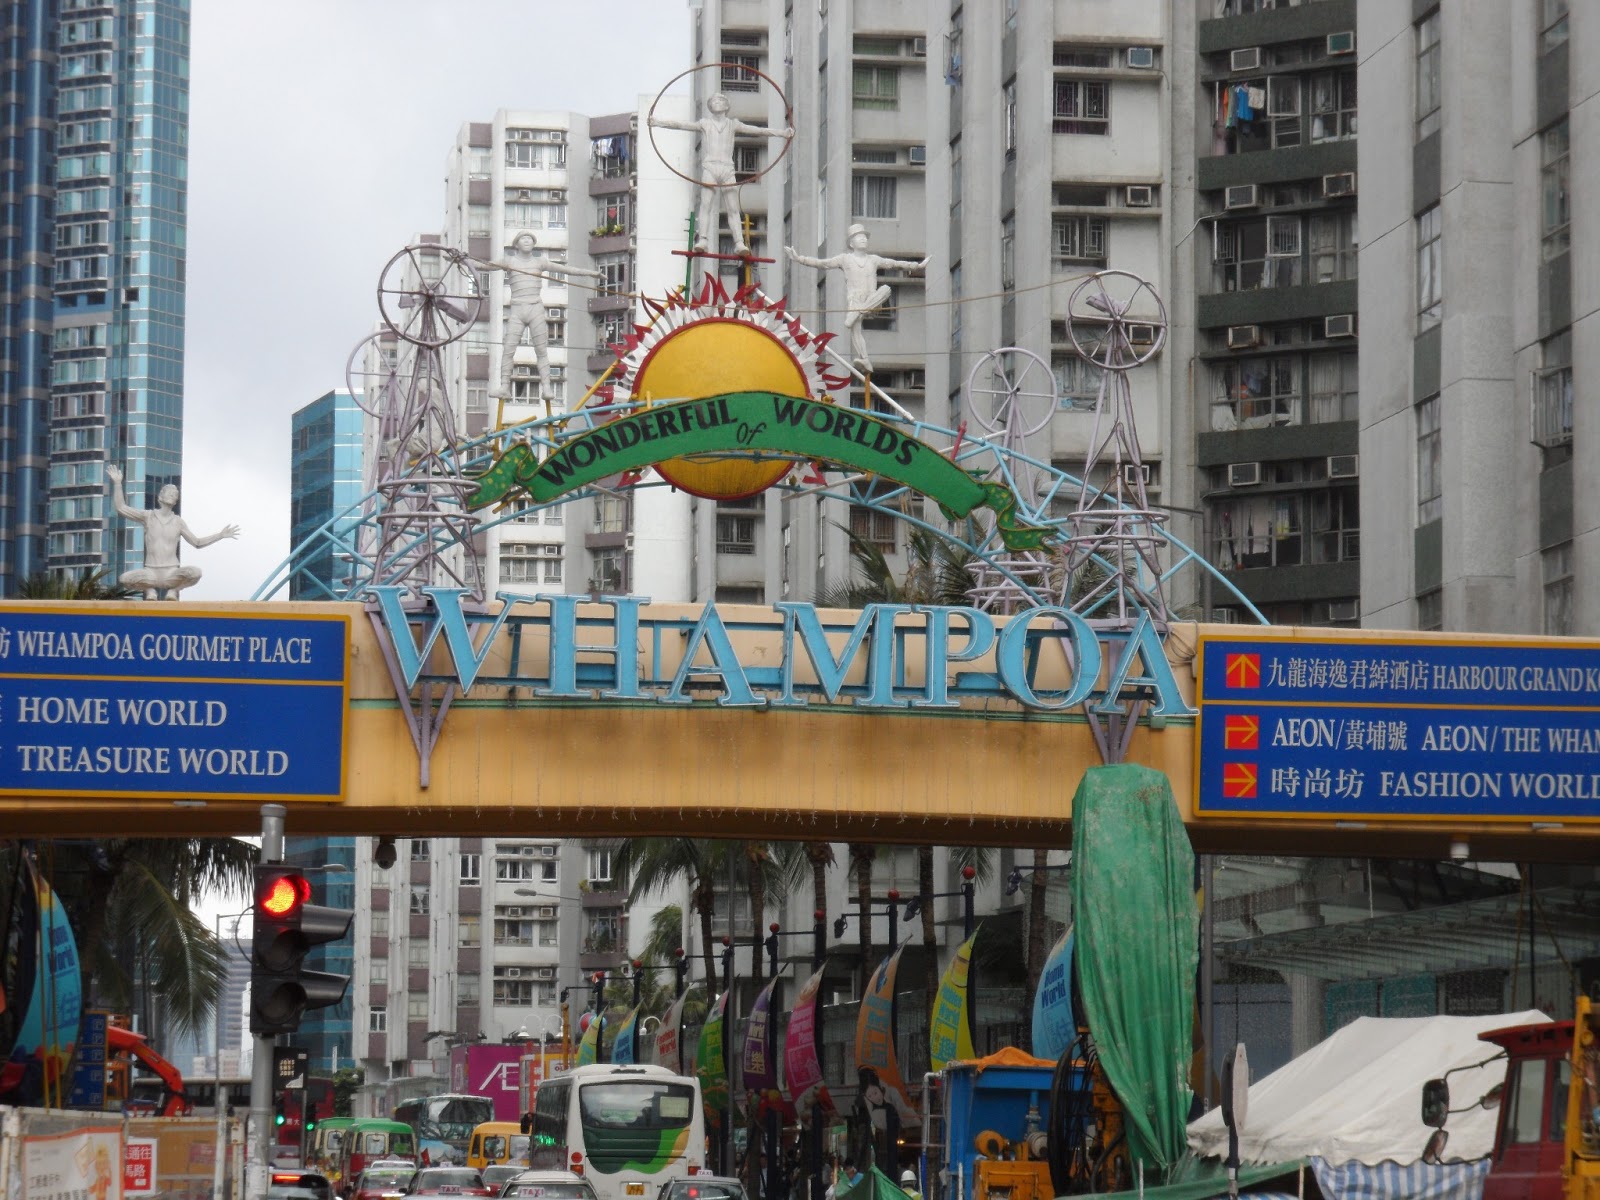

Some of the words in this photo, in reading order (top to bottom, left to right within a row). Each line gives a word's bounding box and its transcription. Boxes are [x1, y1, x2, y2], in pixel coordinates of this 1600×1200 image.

[537, 397, 738, 487] WONDERFUL
[769, 395, 923, 466] WORLDS
[17, 630, 134, 661] WHAMPOA
[139, 633, 244, 662] GOURMET
[248, 637, 312, 664] PLACE
[362, 583, 1201, 717] WHAMPOA
[1267, 657, 1429, 690] 九龍海逸君綽酒店
[1432, 665, 1518, 691] HARBOUR
[1520, 666, 1584, 692] GRAND
[1585, 668, 1600, 692] K
[17, 696, 110, 725] HOME
[117, 699, 227, 727] WORLD
[17, 745, 170, 774] TREASURE
[178, 748, 289, 776] WORLD
[1271, 766, 1365, 799] 時尚坊
[1379, 771, 1502, 798] FASHION
[1044, 963, 1065, 989] Home
[1041, 979, 1066, 1009] World
[125, 1146, 152, 1160] 通往
[523, 1188, 544, 1196] TAXI
